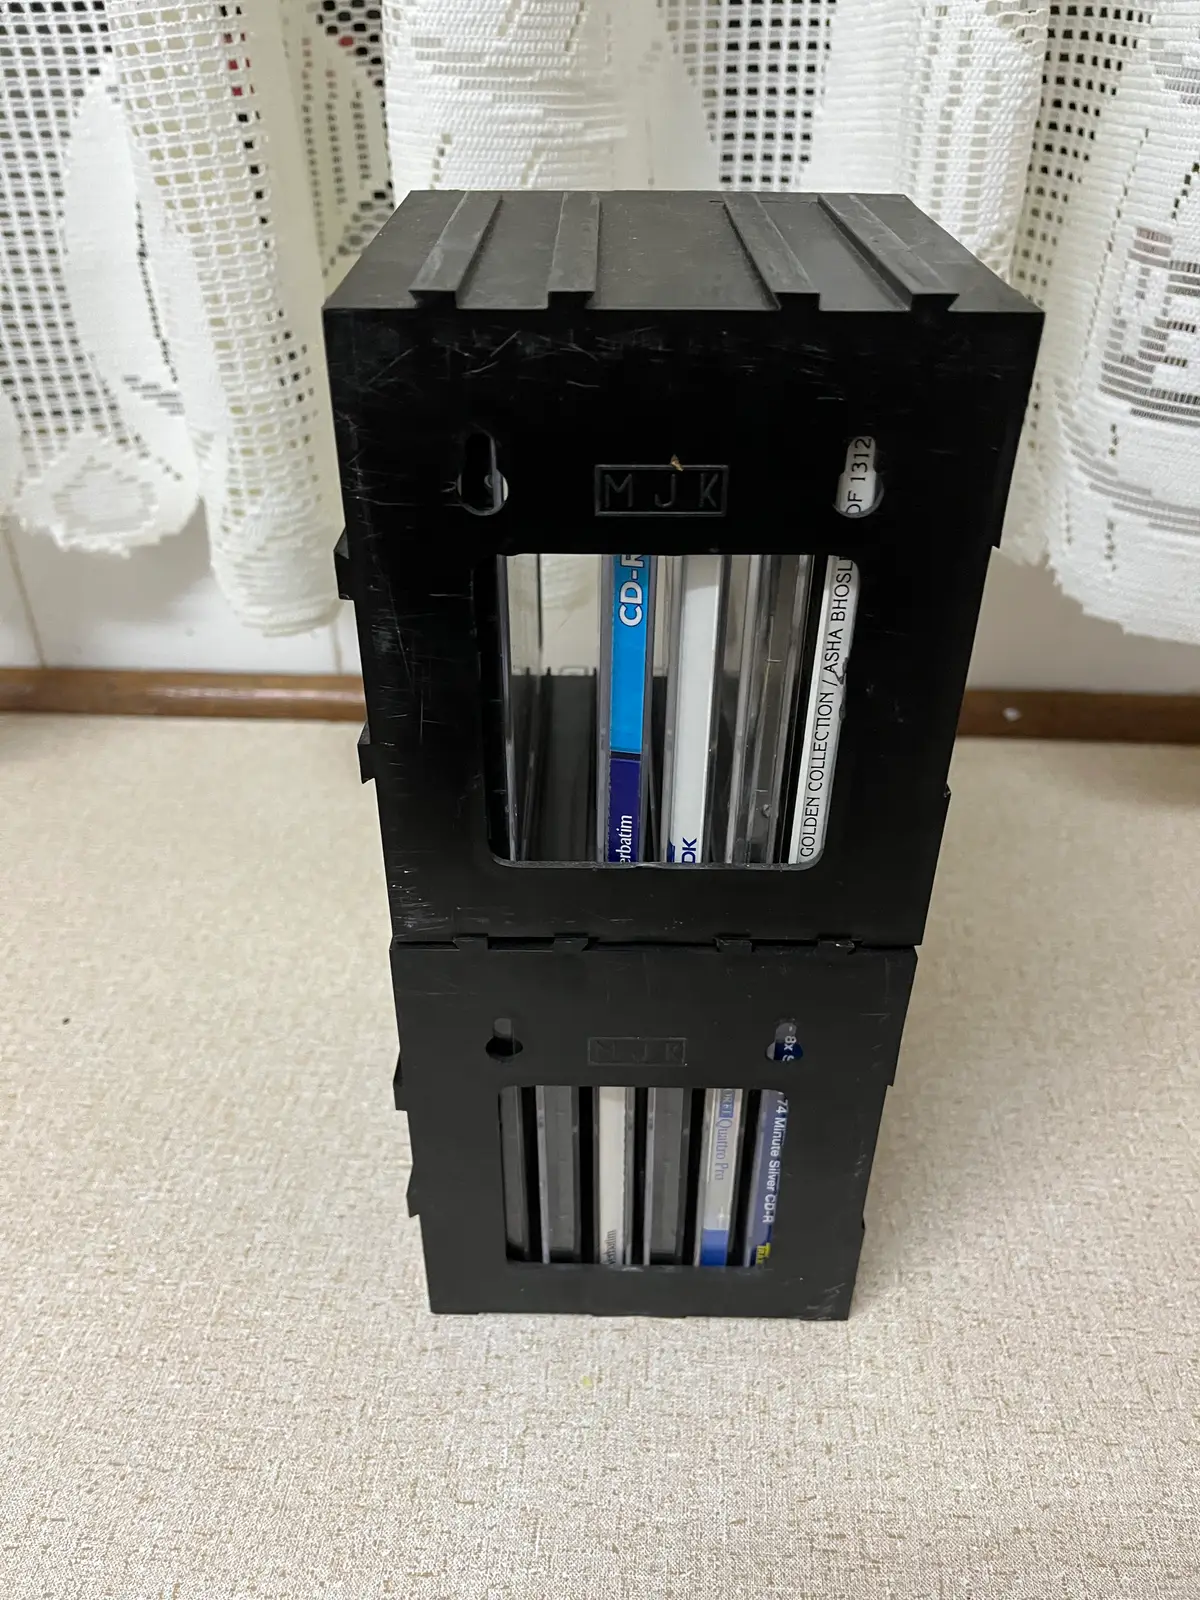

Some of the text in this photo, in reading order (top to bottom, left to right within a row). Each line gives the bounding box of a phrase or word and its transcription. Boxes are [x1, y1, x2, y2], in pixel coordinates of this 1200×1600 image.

[850, 438, 873, 482] 1312
[823, 628, 843, 673] ASHA
[807, 692, 834, 791] COLLECTION
[800, 796, 820, 857] GOLDEN
[715, 1118, 733, 1160] Quattro
[762, 1099, 788, 1223] 74 Minute Silver CD-R
